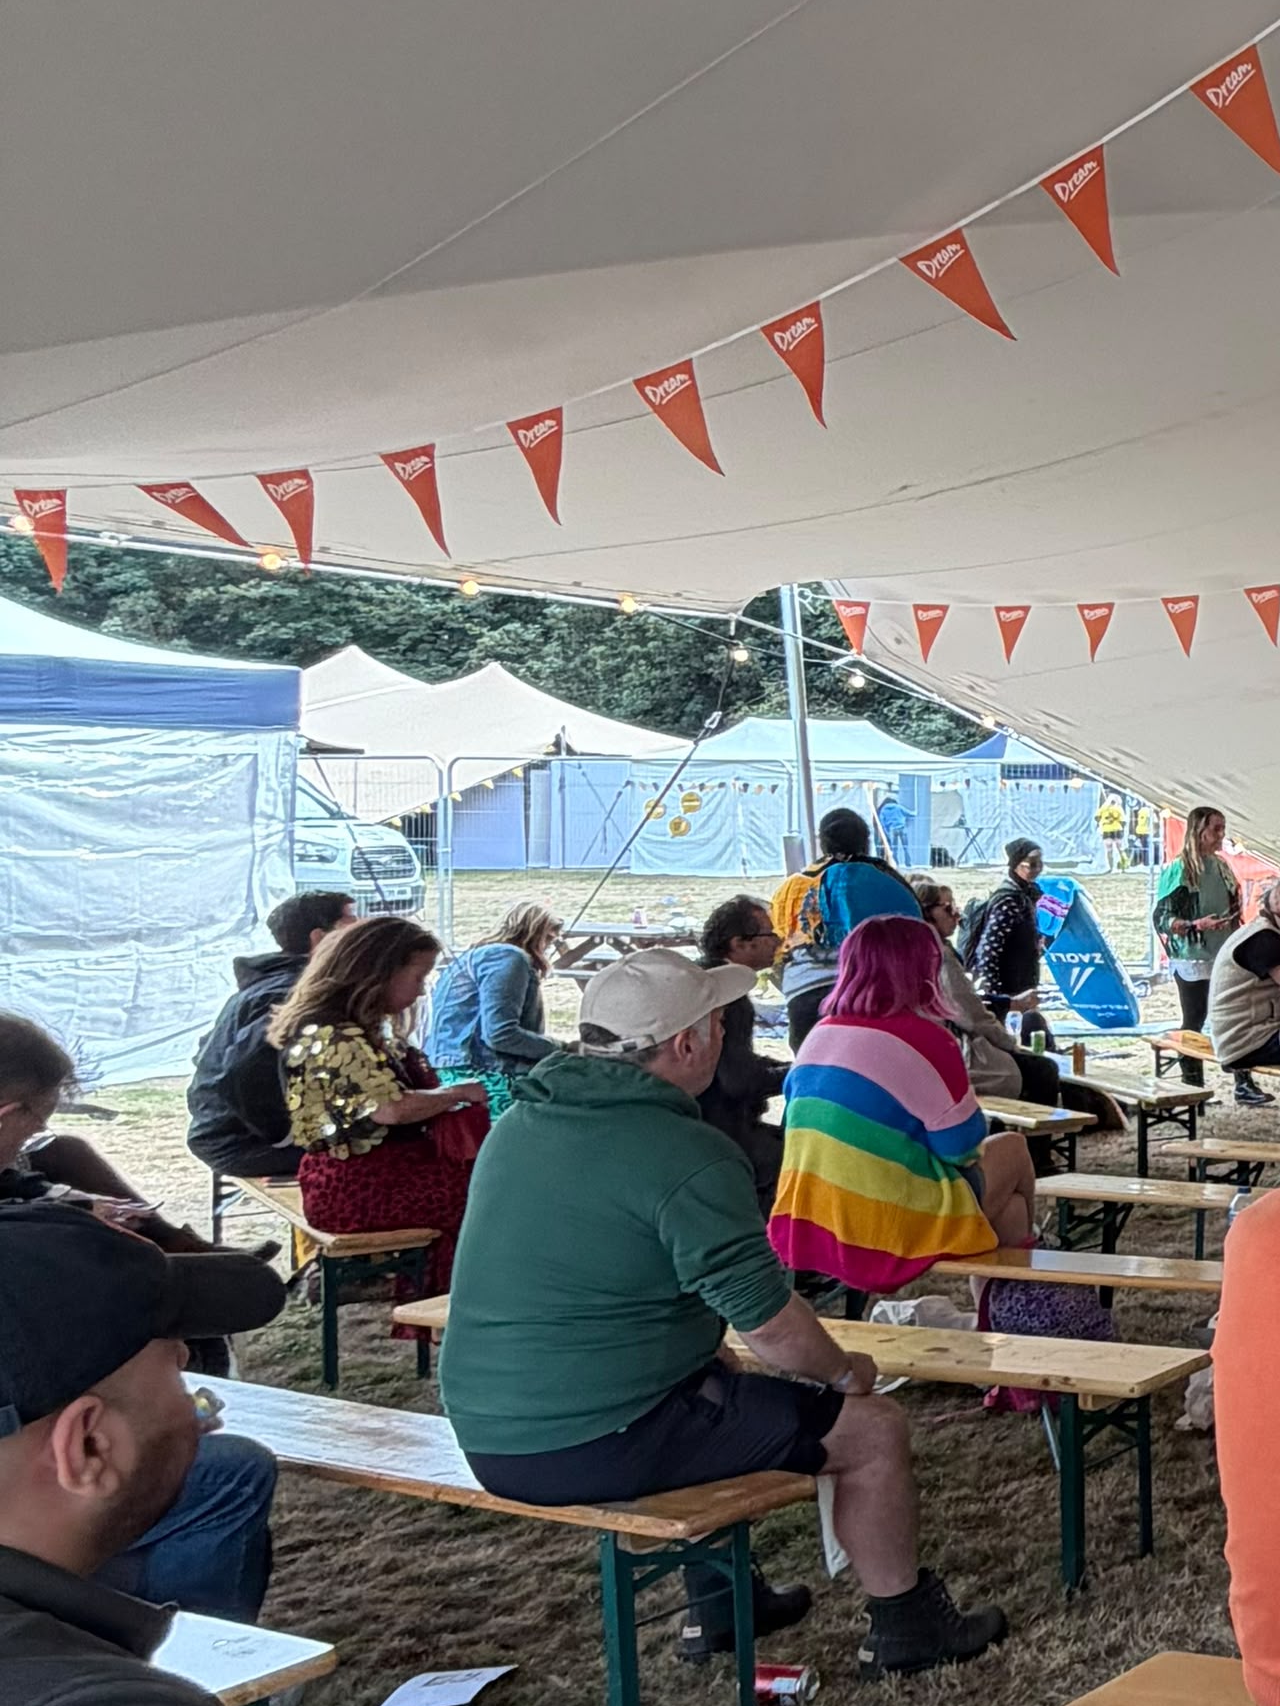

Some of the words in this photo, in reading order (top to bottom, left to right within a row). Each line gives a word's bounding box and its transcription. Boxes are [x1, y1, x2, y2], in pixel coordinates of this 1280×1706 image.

[1205, 63, 1256, 109] Dream
[1054, 161, 1100, 204] Dream
[917, 244, 964, 278] Dream
[774, 318, 817, 351] Dream
[645, 374, 691, 405] Dream
[518, 420, 558, 448] Dream
[394, 456, 431, 480] Dream
[268, 478, 307, 501] Dream
[23, 499, 62, 518] Dream
